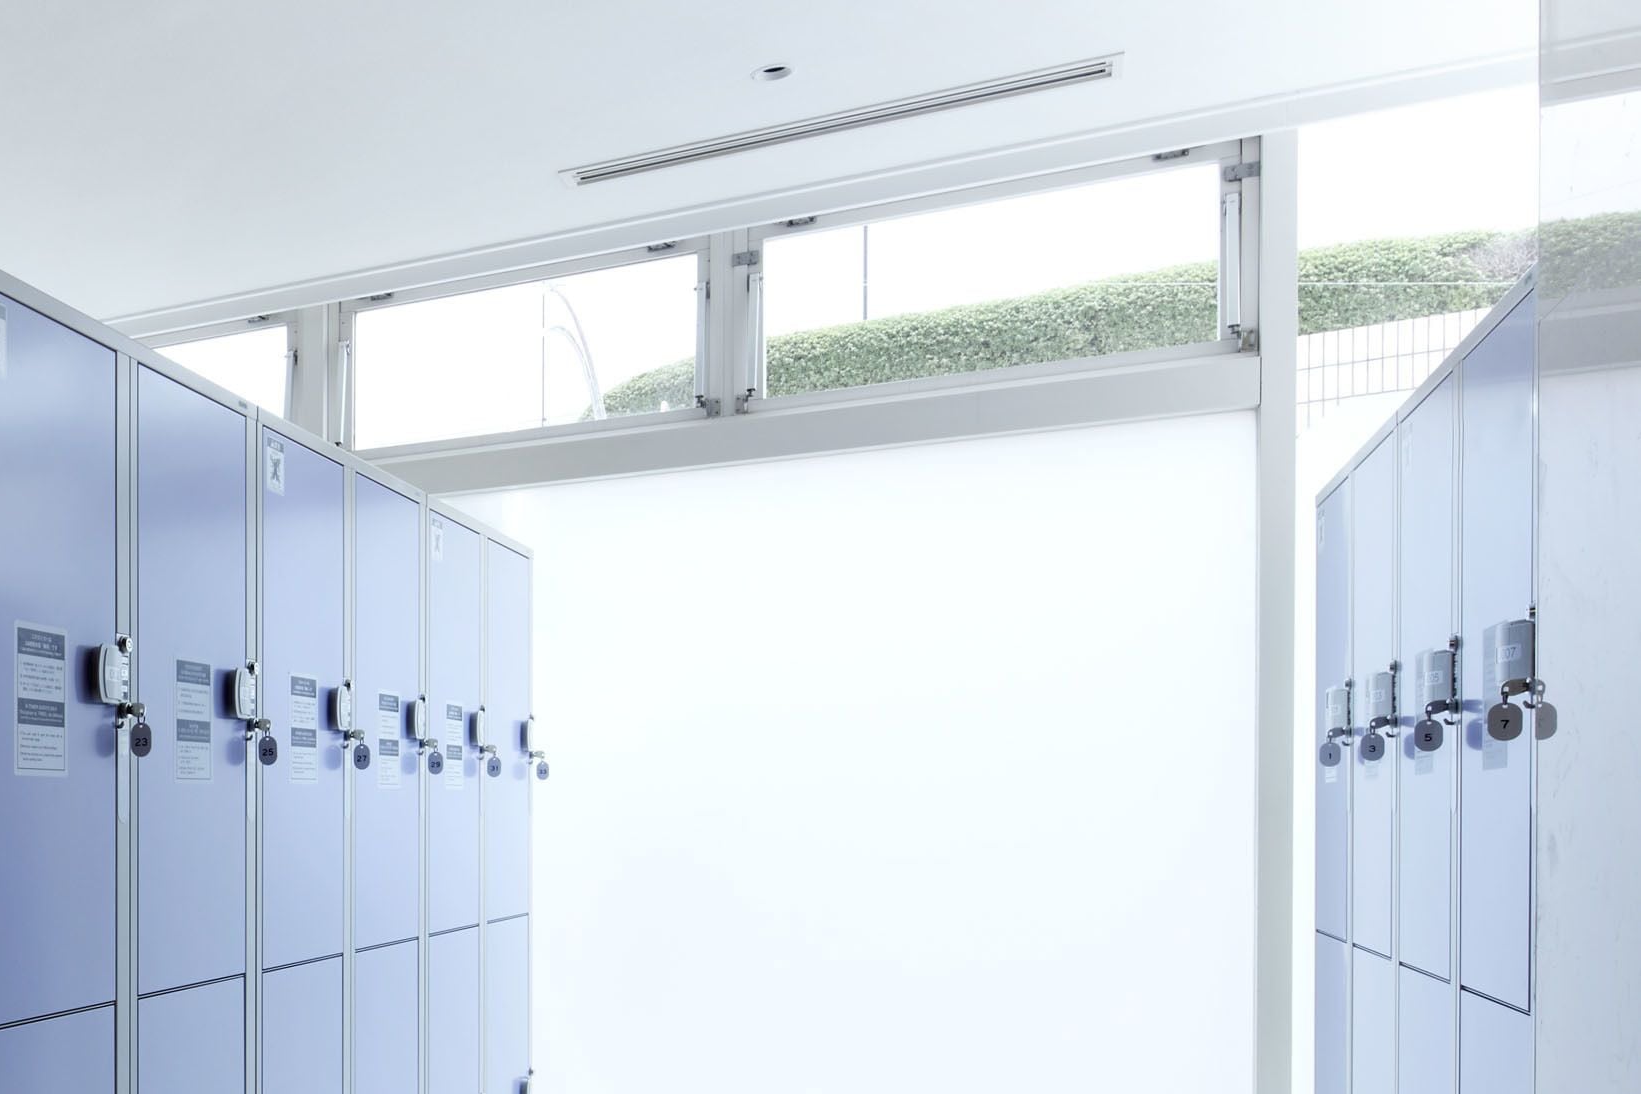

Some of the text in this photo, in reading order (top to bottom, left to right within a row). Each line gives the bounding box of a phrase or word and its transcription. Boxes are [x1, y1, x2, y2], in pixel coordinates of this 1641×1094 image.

[1501, 720, 1510, 729] 7
[134, 737, 148, 747] 23
[1424, 733, 1432, 742] 5
[262, 748, 274, 756] 25
[356, 754, 367, 763] 27
